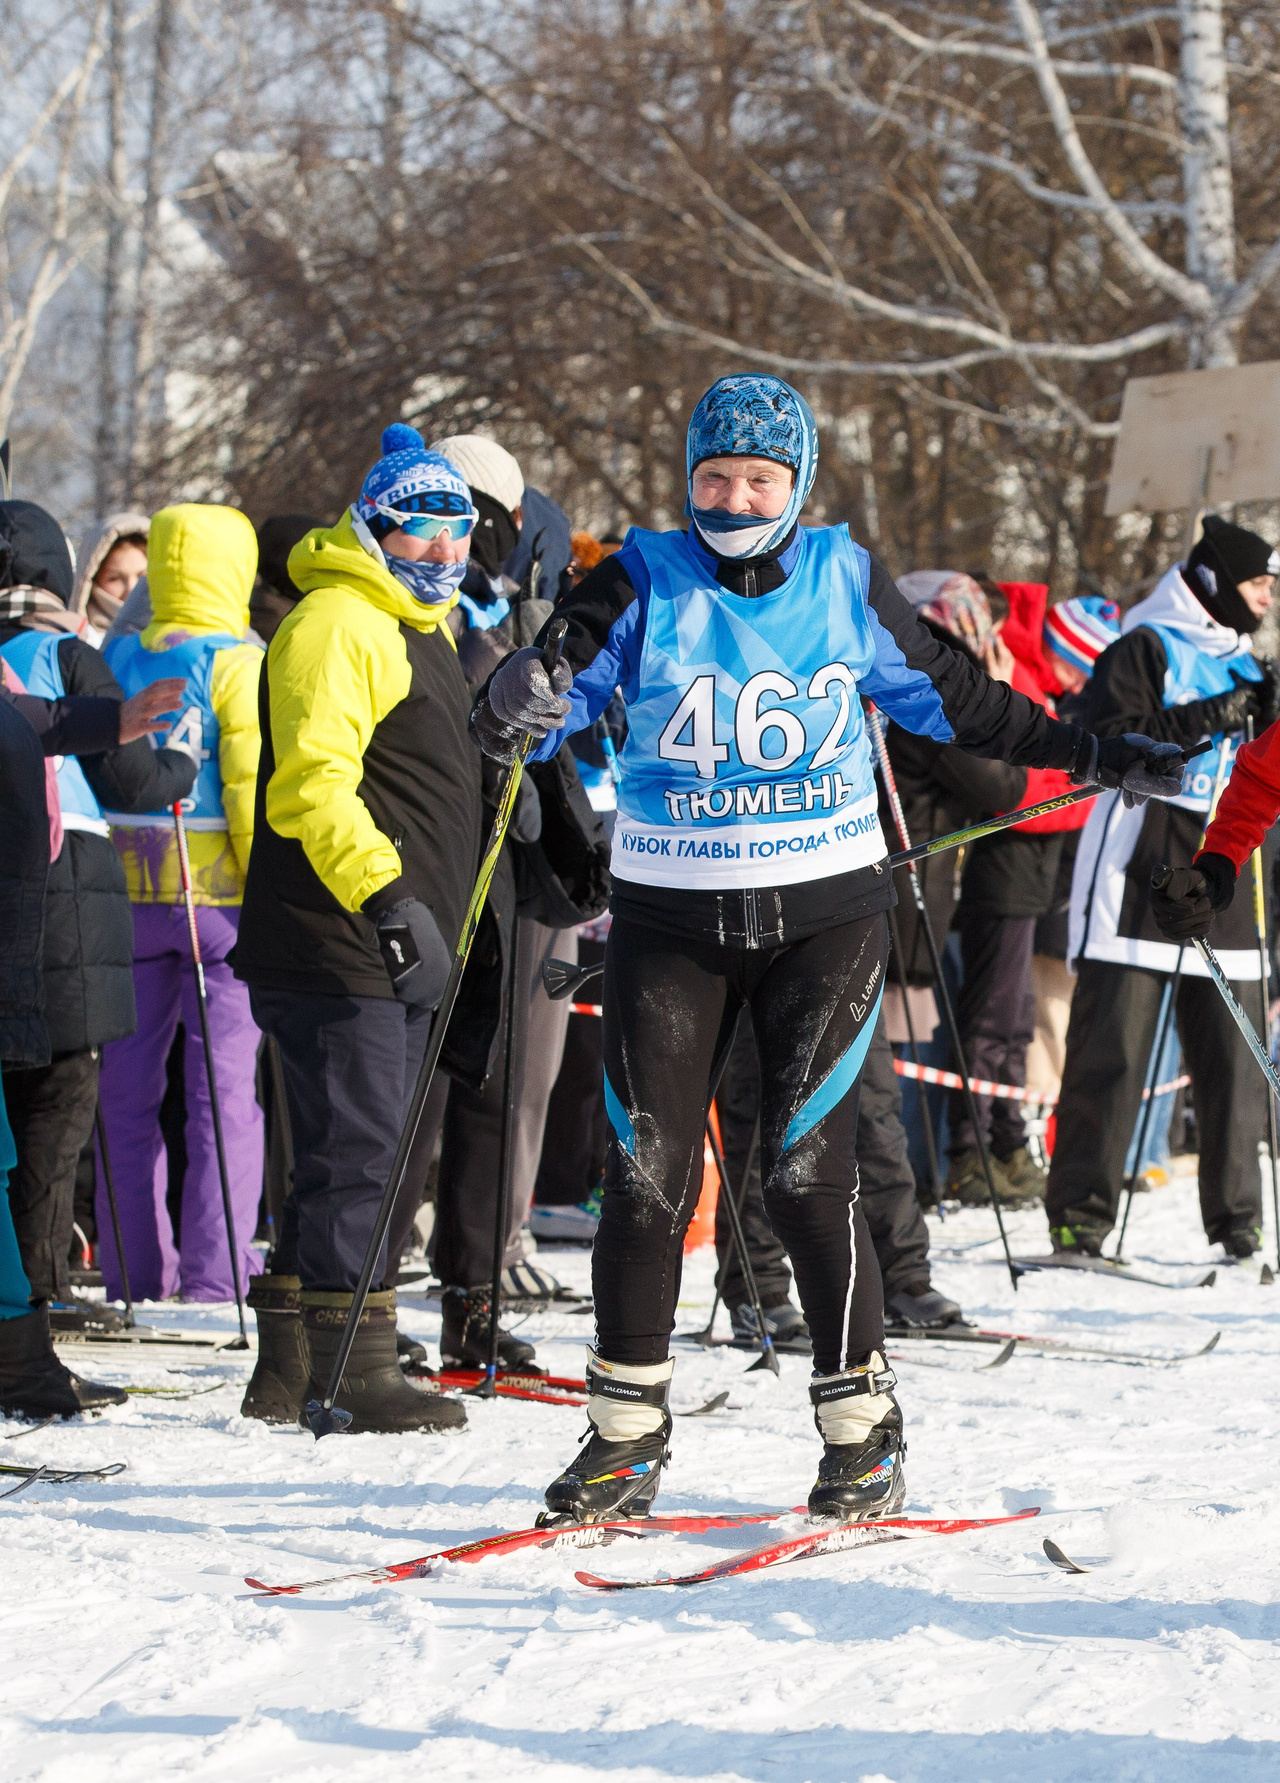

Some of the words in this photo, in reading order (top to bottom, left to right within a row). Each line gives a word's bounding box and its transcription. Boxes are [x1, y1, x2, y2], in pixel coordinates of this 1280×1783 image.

[387, 478, 464, 503] RUSSIA
[390, 494, 472, 520] USSI
[658, 661, 856, 780] 462
[664, 773, 853, 821] ТЮМЕНЬ
[621, 832, 671, 857] КУБОК
[677, 839, 740, 859] ГЛАВЫ
[749, 831, 830, 859] ГОРОДА
[861, 960, 882, 1002] Löffler
[602, 1384, 643, 1397] SALOMON
[819, 1384, 857, 1397] SALOMON
[553, 1526, 606, 1551] ATOMIC
